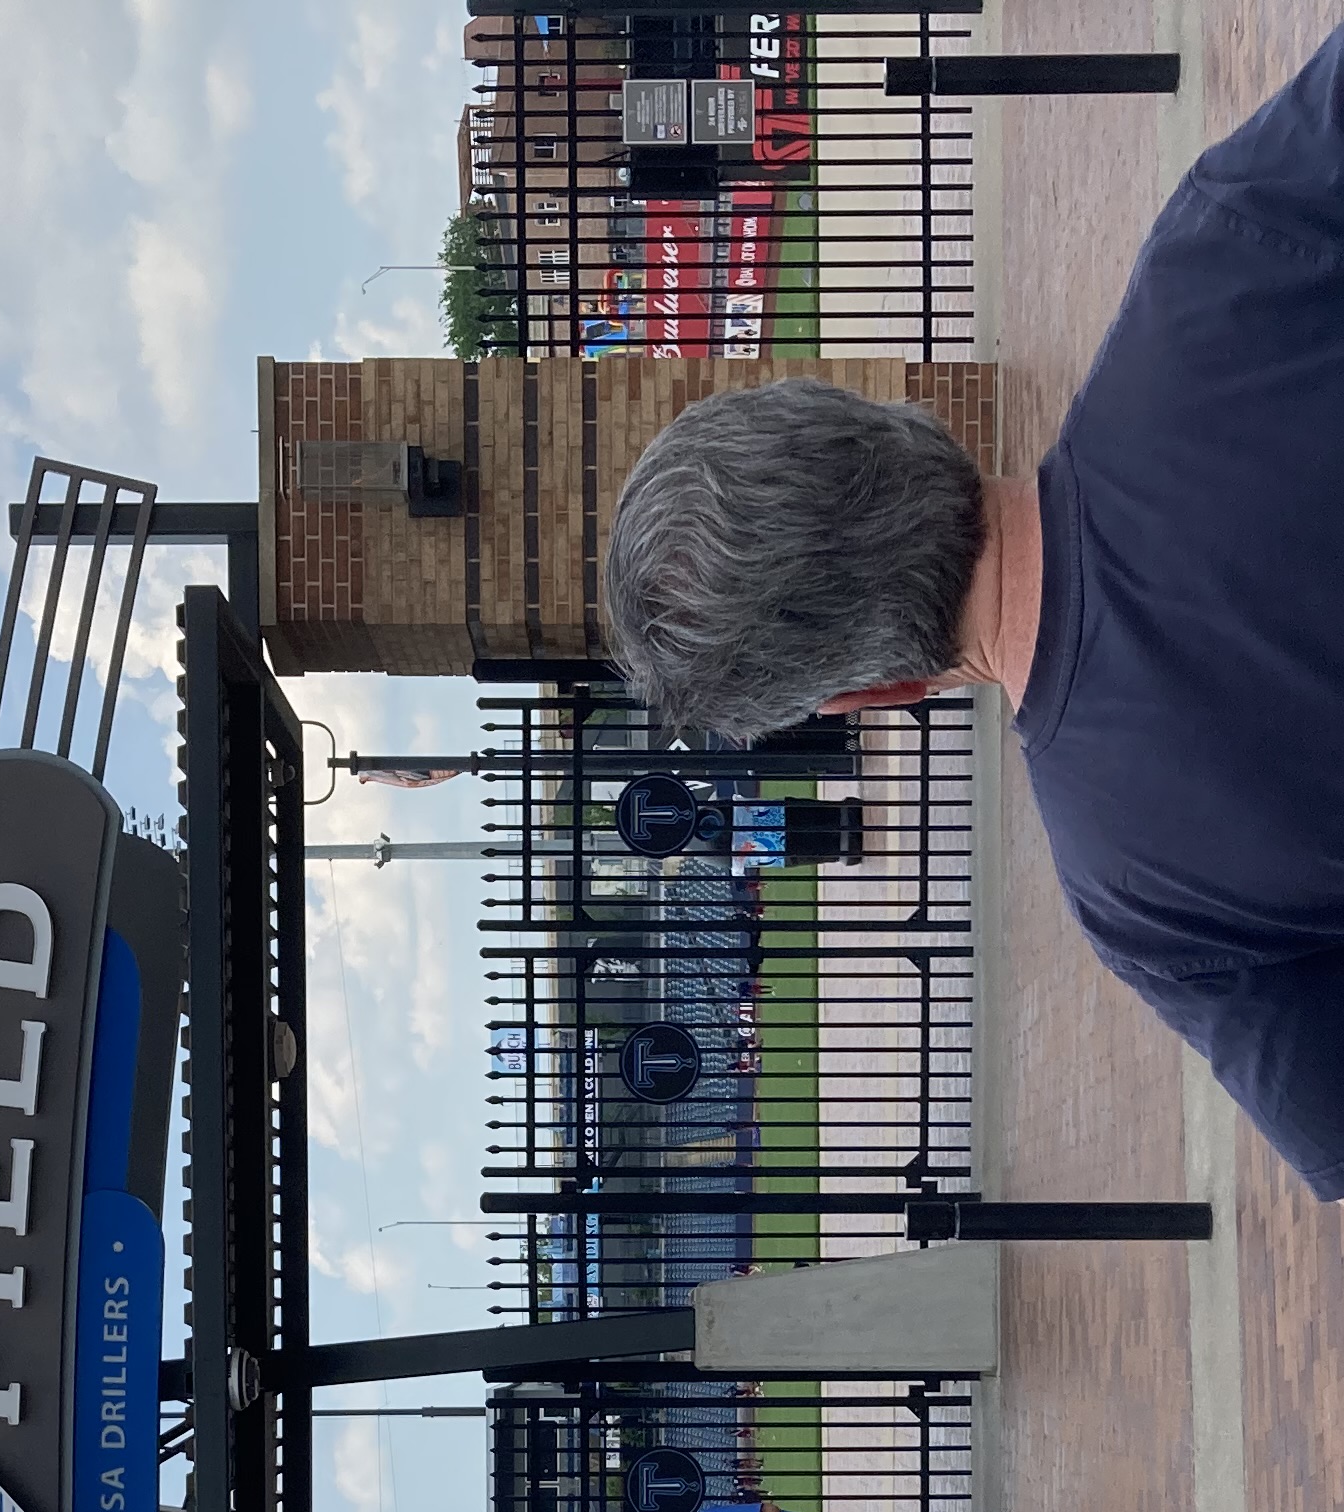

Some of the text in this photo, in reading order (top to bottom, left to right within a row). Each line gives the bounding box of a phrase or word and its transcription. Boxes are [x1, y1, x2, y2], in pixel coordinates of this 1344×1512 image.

[750, 14, 780, 78] FER
[508, 1033, 521, 1070] BUCH
[101, 1276, 130, 1449] DRILLERS
